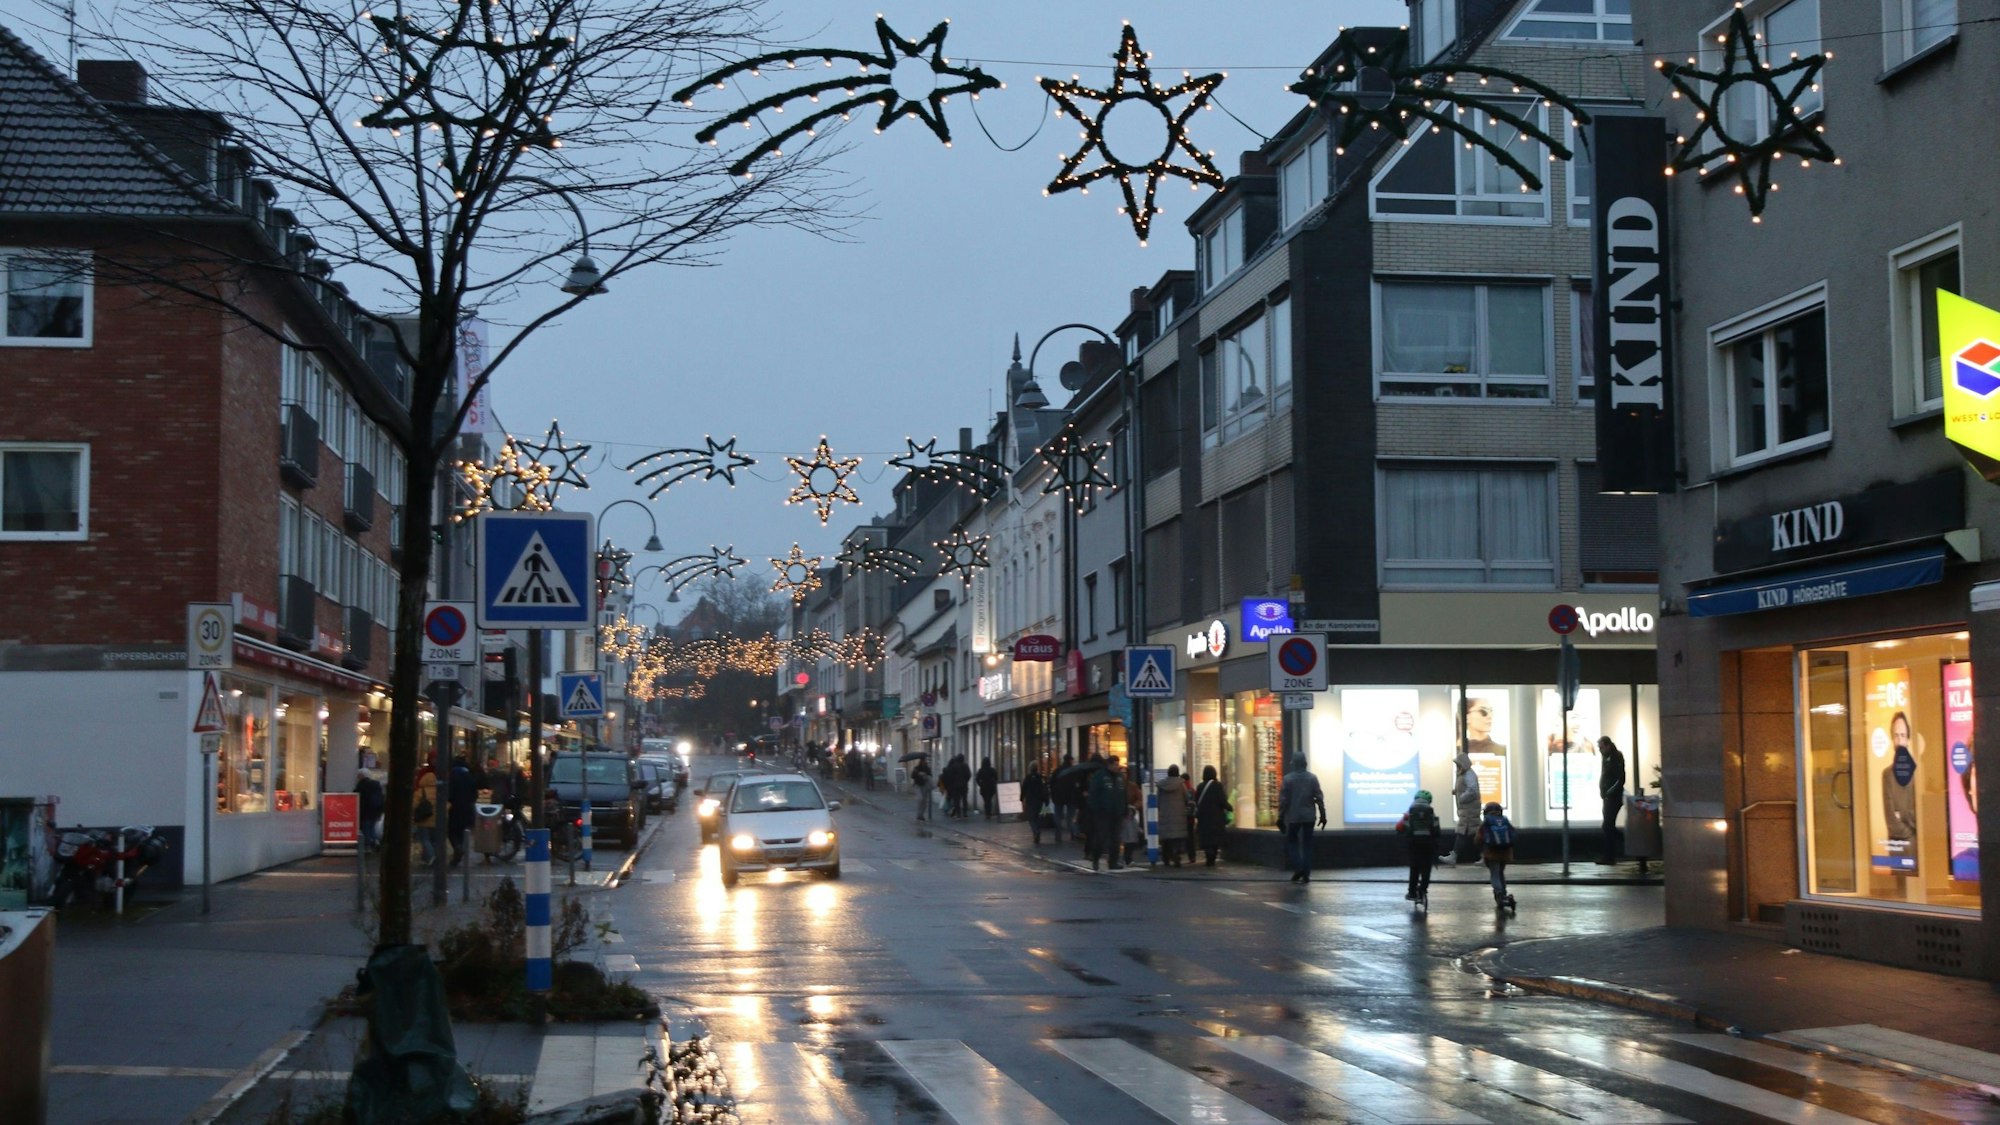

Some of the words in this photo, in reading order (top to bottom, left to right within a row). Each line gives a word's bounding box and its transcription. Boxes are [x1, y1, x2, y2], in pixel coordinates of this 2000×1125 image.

[1607, 197, 1664, 410] KIND
[1771, 501, 1844, 552] KIND
[1757, 588, 1788, 609] KIND
[1792, 580, 1847, 604] HÖRGERÄTE
[202, 620, 220, 640] 30
[429, 648, 461, 659] ZONE
[1020, 643, 1053, 654] kraus
[199, 655, 222, 666] ZONE
[1284, 678, 1313, 688] ZONE
